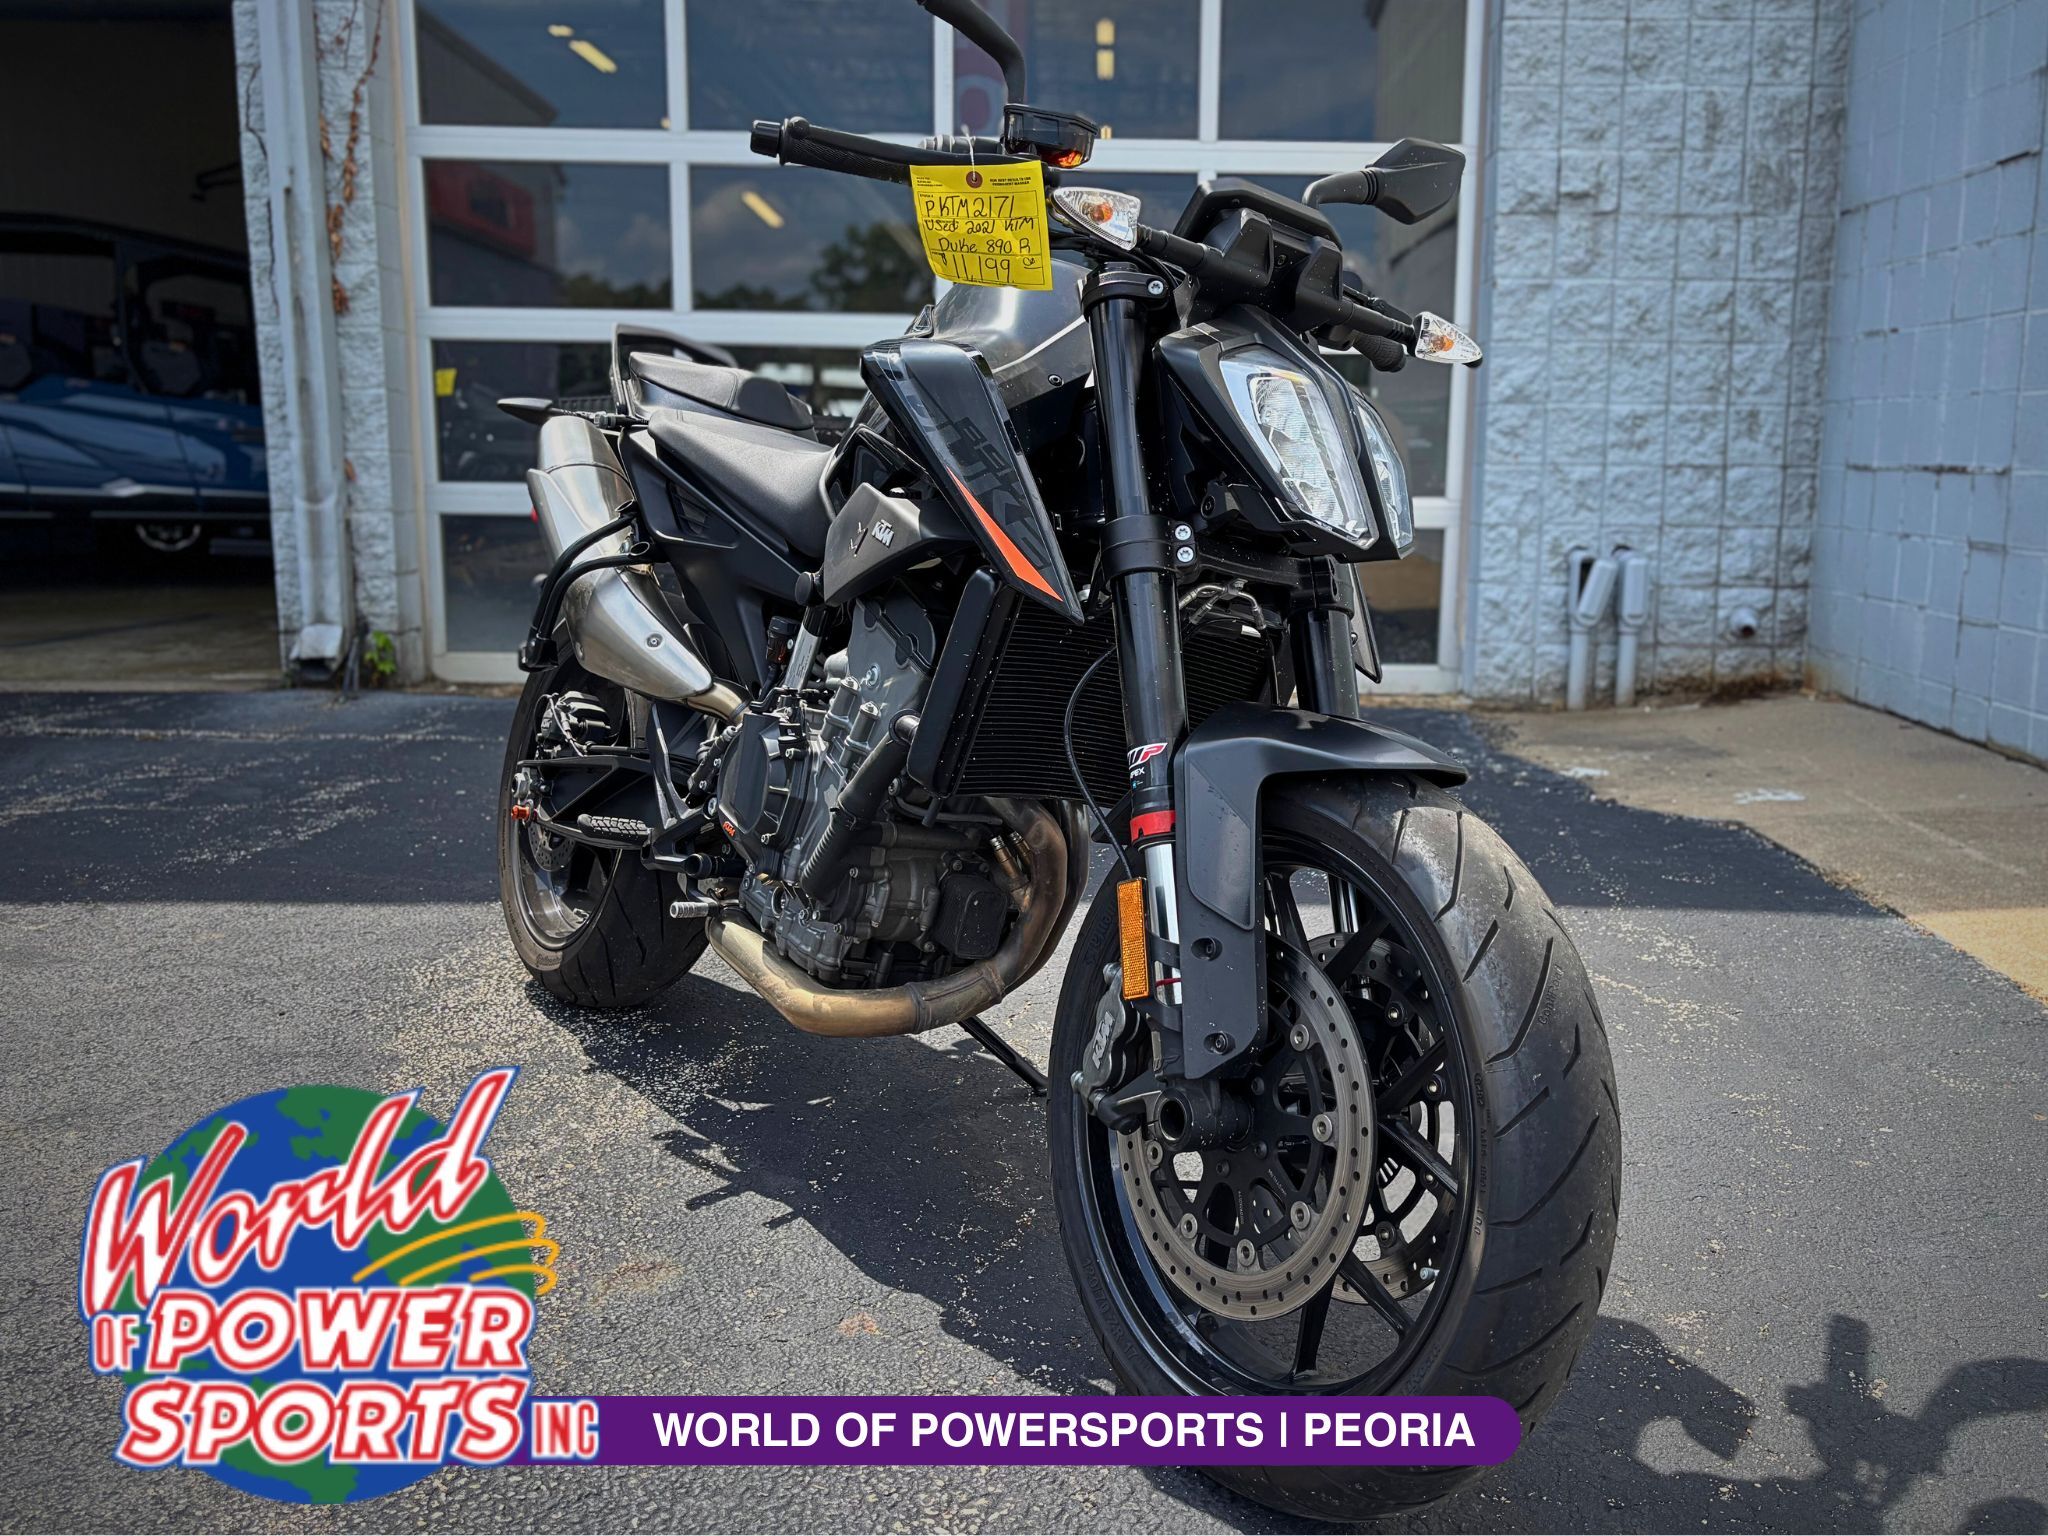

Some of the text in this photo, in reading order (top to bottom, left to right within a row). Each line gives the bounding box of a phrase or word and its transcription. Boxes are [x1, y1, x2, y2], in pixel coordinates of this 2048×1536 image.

[965, 219, 996, 234] 2021
[1004, 216, 1034, 232] KTM
[986, 238, 1013, 254] 890
[1019, 237, 1032, 254] R
[871, 519, 895, 548] KTM
[1129, 766, 1145, 779] PEX
[1091, 1011, 1116, 1070] KTM
